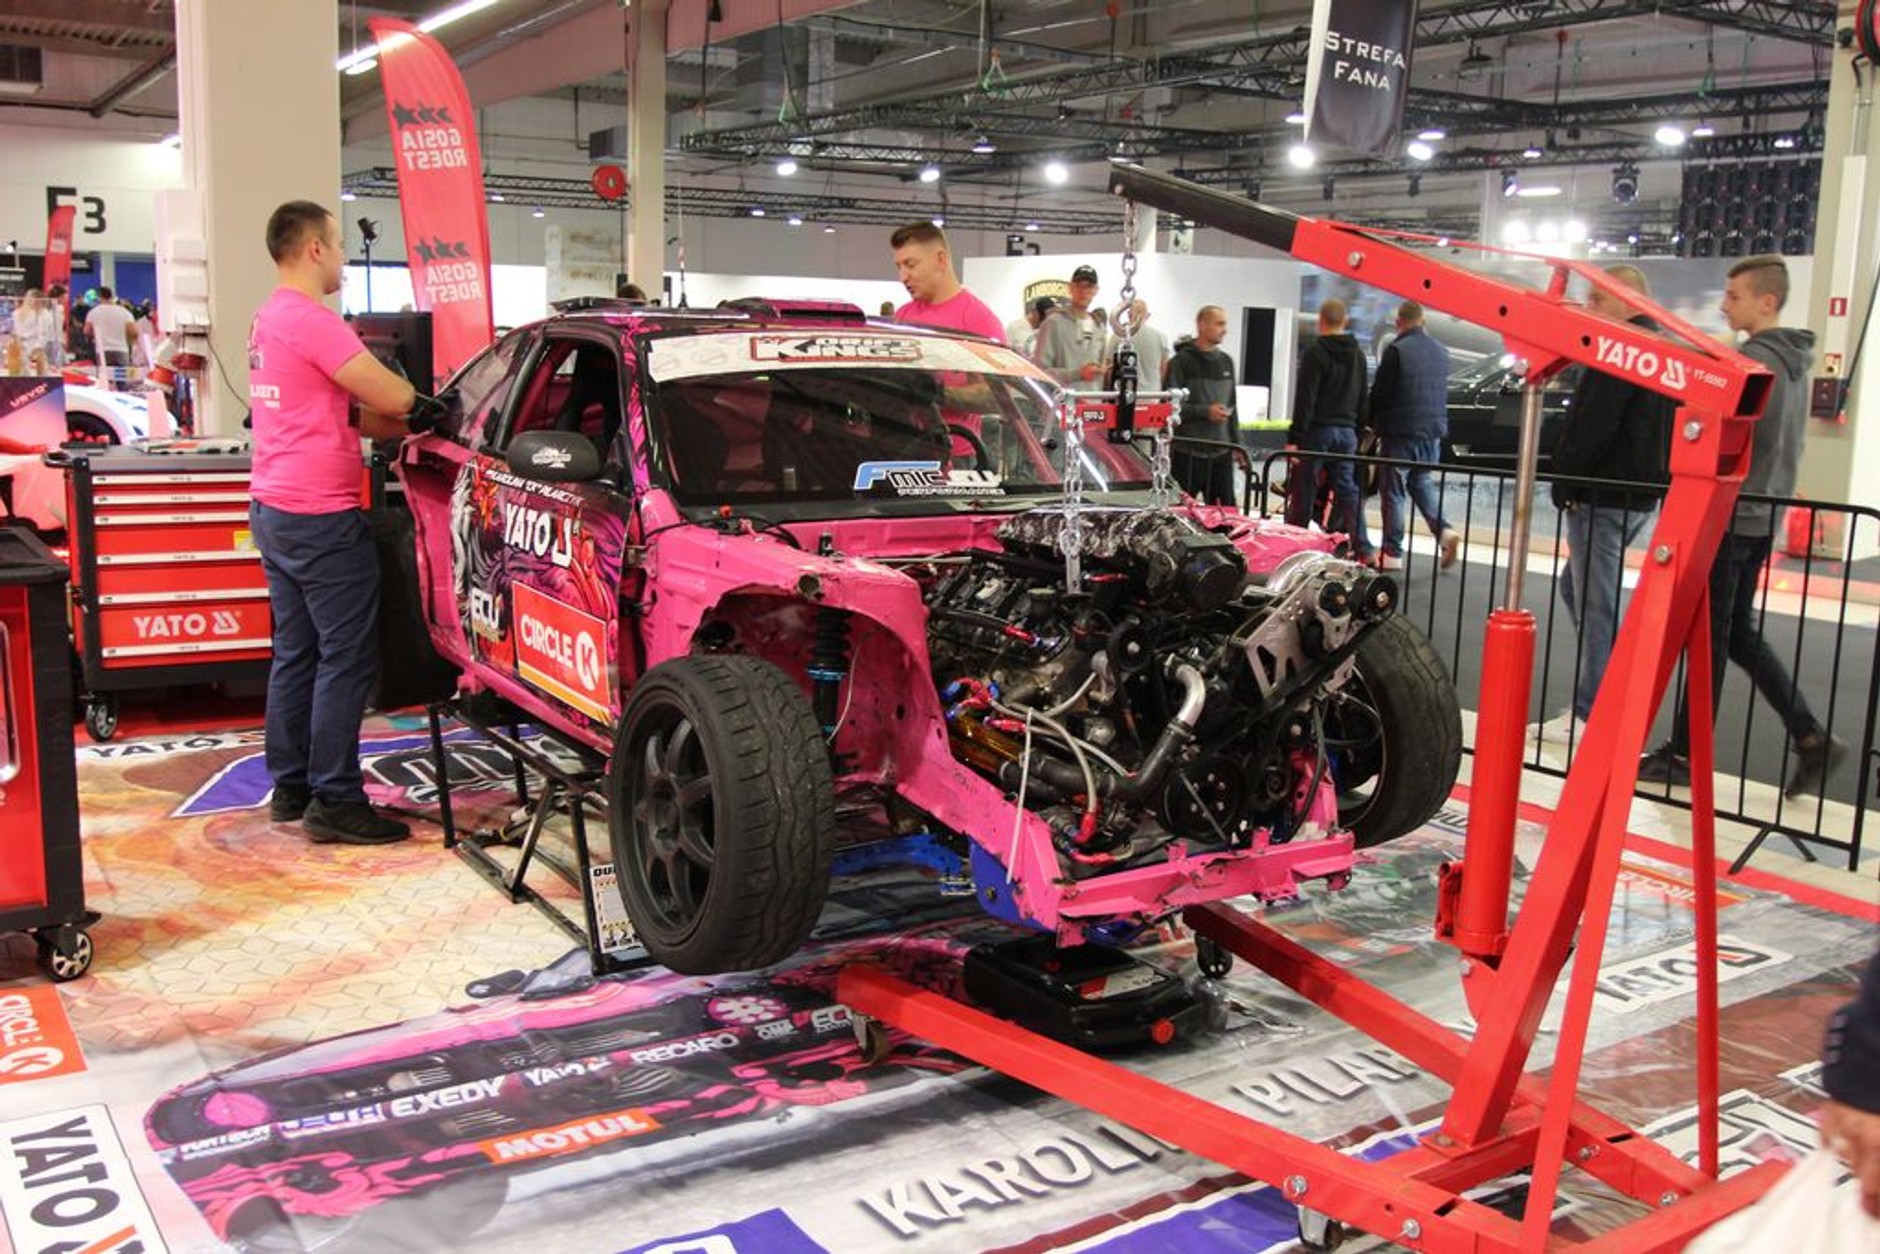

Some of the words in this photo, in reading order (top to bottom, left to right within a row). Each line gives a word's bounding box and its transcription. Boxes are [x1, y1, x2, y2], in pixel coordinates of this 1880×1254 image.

[1325, 31, 1406, 69] STREFA
[1334, 60, 1390, 91] FANA
[1596, 335, 1660, 378] YATO
[504, 502, 551, 558] YATO
[133, 613, 206, 638] YATO
[520, 614, 574, 669] CIRCLE
[576, 632, 600, 691] K
[92, 736, 223, 758] YATO
[0, 995, 44, 1047] CIRCLE
[391, 1074, 507, 1118] EXEDY
[630, 1032, 739, 1064] RECARO
[494, 1110, 651, 1159] MOTUL
[10, 1114, 121, 1228] YATO
[857, 1124, 1182, 1240] KAROLI
